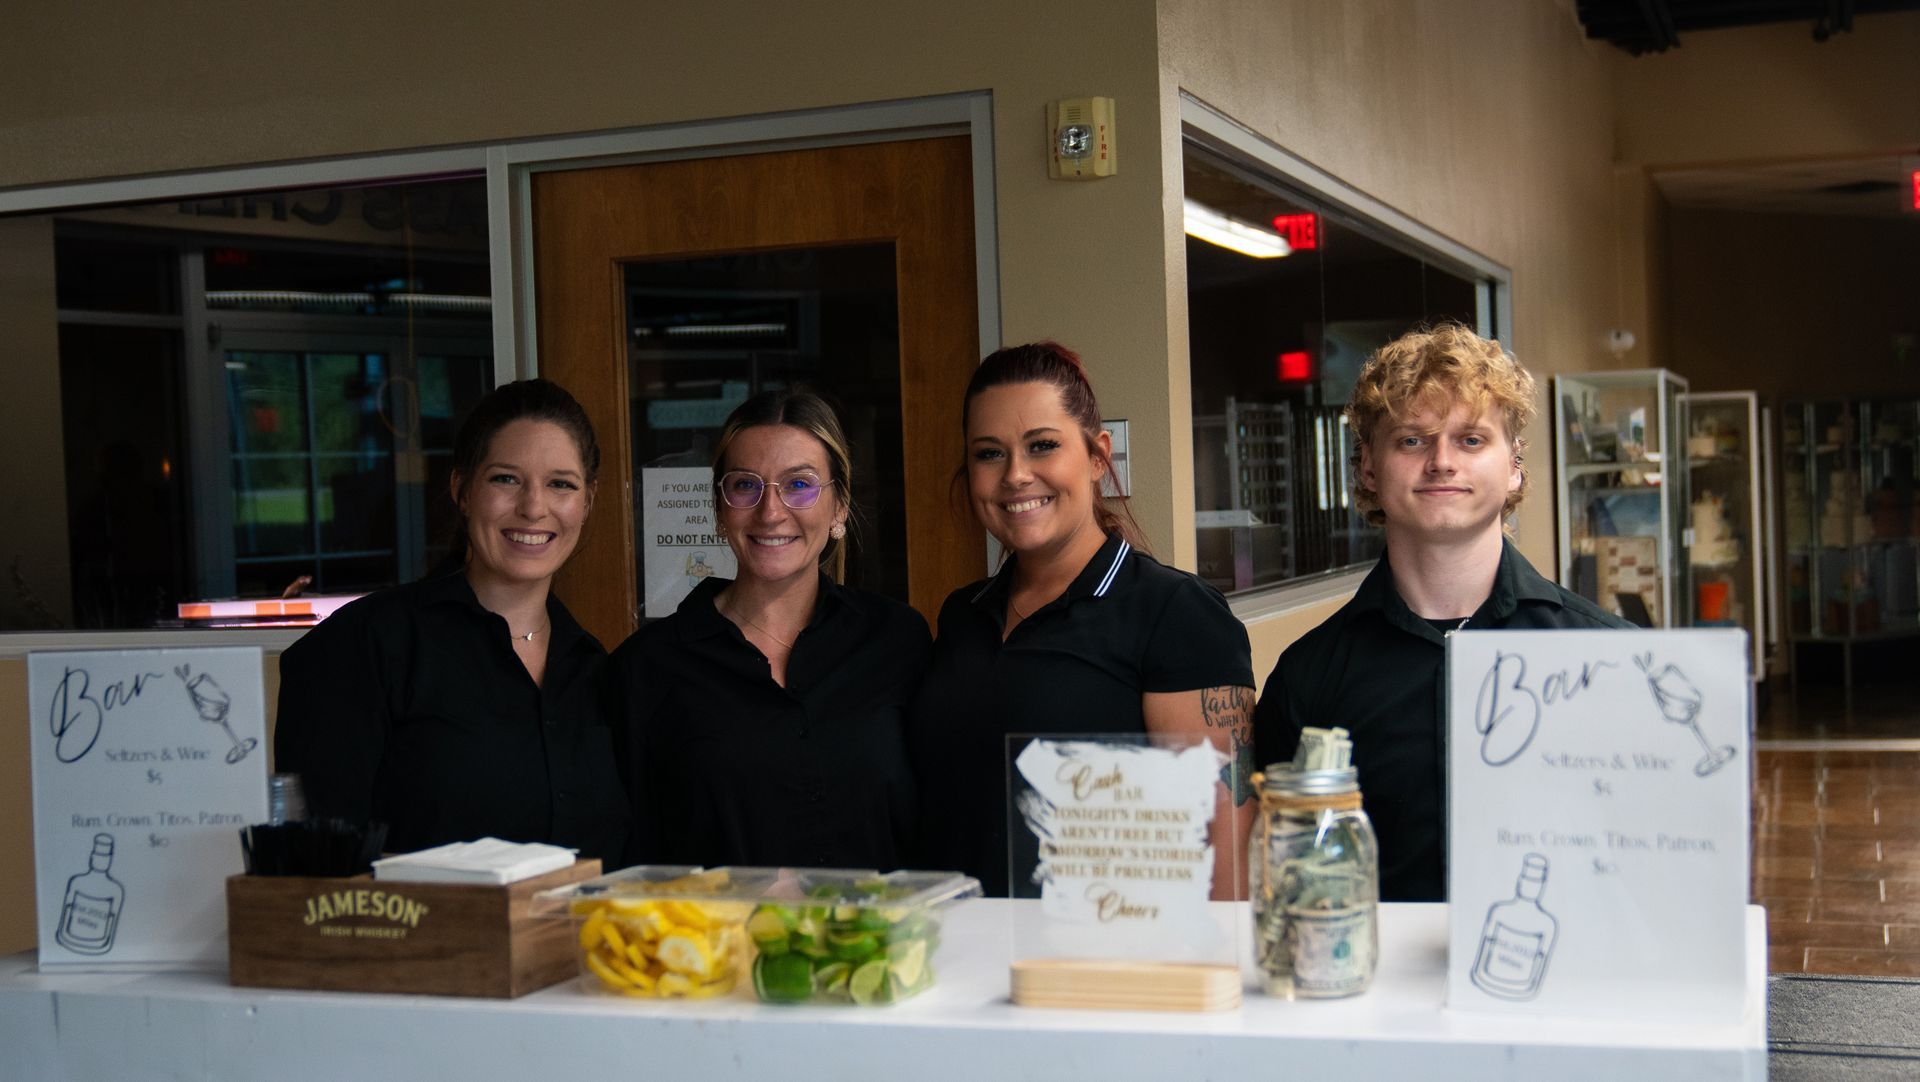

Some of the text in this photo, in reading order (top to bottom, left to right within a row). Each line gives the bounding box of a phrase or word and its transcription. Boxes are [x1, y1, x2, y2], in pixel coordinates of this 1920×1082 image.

[662, 484, 710, 492] IF YOU ARE
[657, 500, 700, 508] ASSIGNED
[685, 516, 708, 524] AREA
[657, 535, 728, 544] DO NOT ENTE
[50, 666, 163, 763] Bar
[1475, 649, 1618, 767] Bar
[161, 747, 173, 761] &
[177, 747, 210, 761] Wine
[1136, 809, 1192, 823] DRINKS
[1115, 867, 1194, 881] PRICELESS
